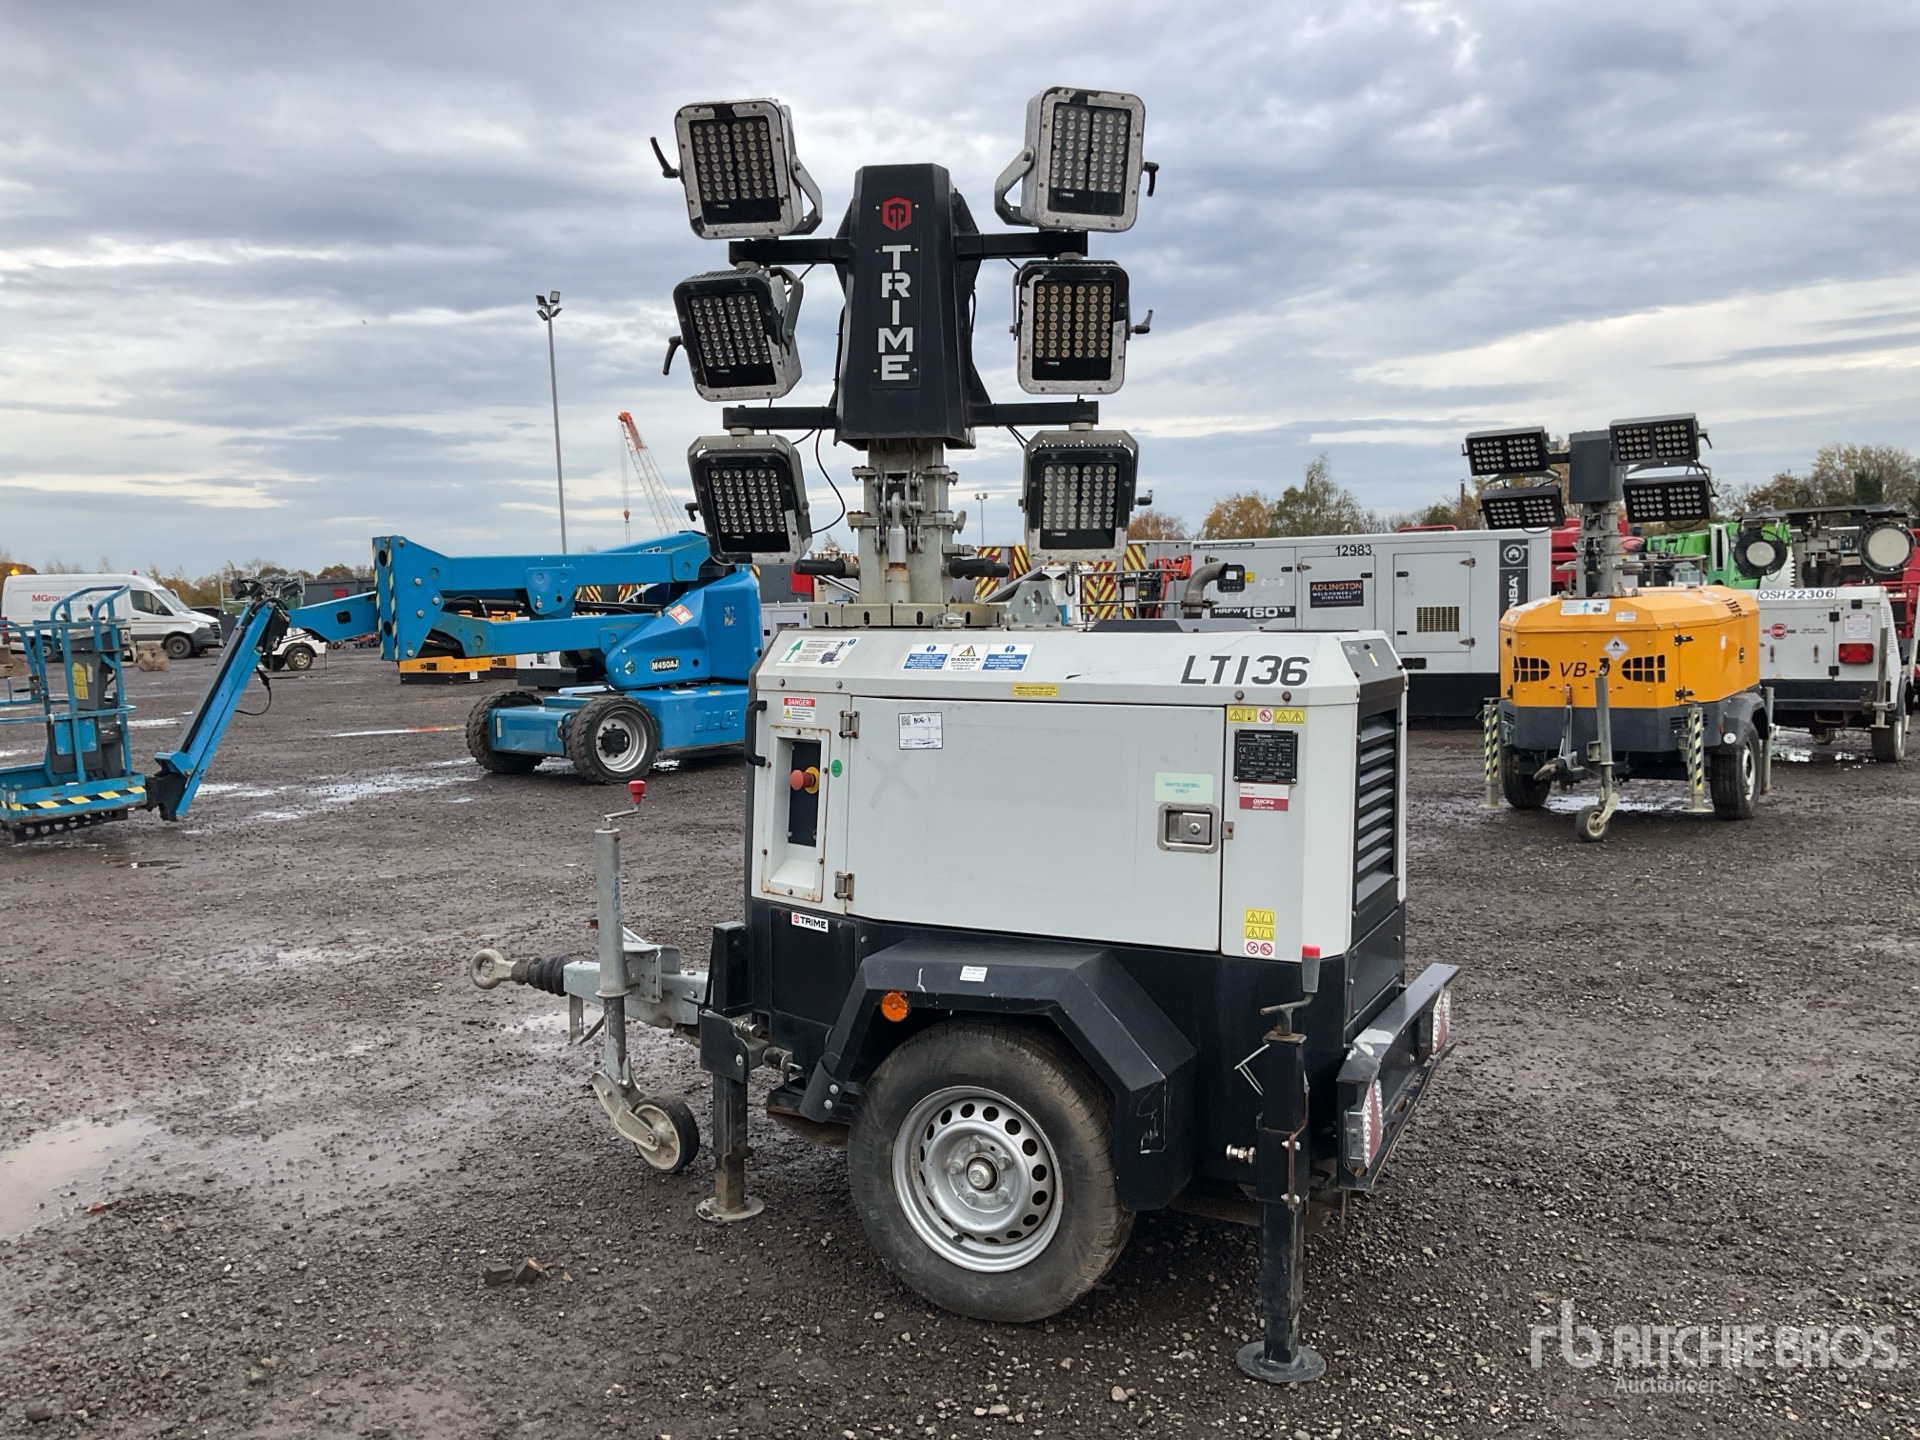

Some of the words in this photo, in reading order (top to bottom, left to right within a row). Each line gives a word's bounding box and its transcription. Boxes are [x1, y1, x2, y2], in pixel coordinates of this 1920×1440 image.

[878, 244, 914, 381] TRIME
[1335, 544, 1372, 556] 12983
[1312, 583, 1362, 591] ADLINGTON
[1760, 589, 1834, 599] OSH22306
[1242, 607, 1279, 618] 160
[651, 659, 679, 670] M450AJ
[1180, 655, 1311, 687] LT136
[787, 699, 812, 707] DANGER!
[800, 915, 827, 930] TRIME
